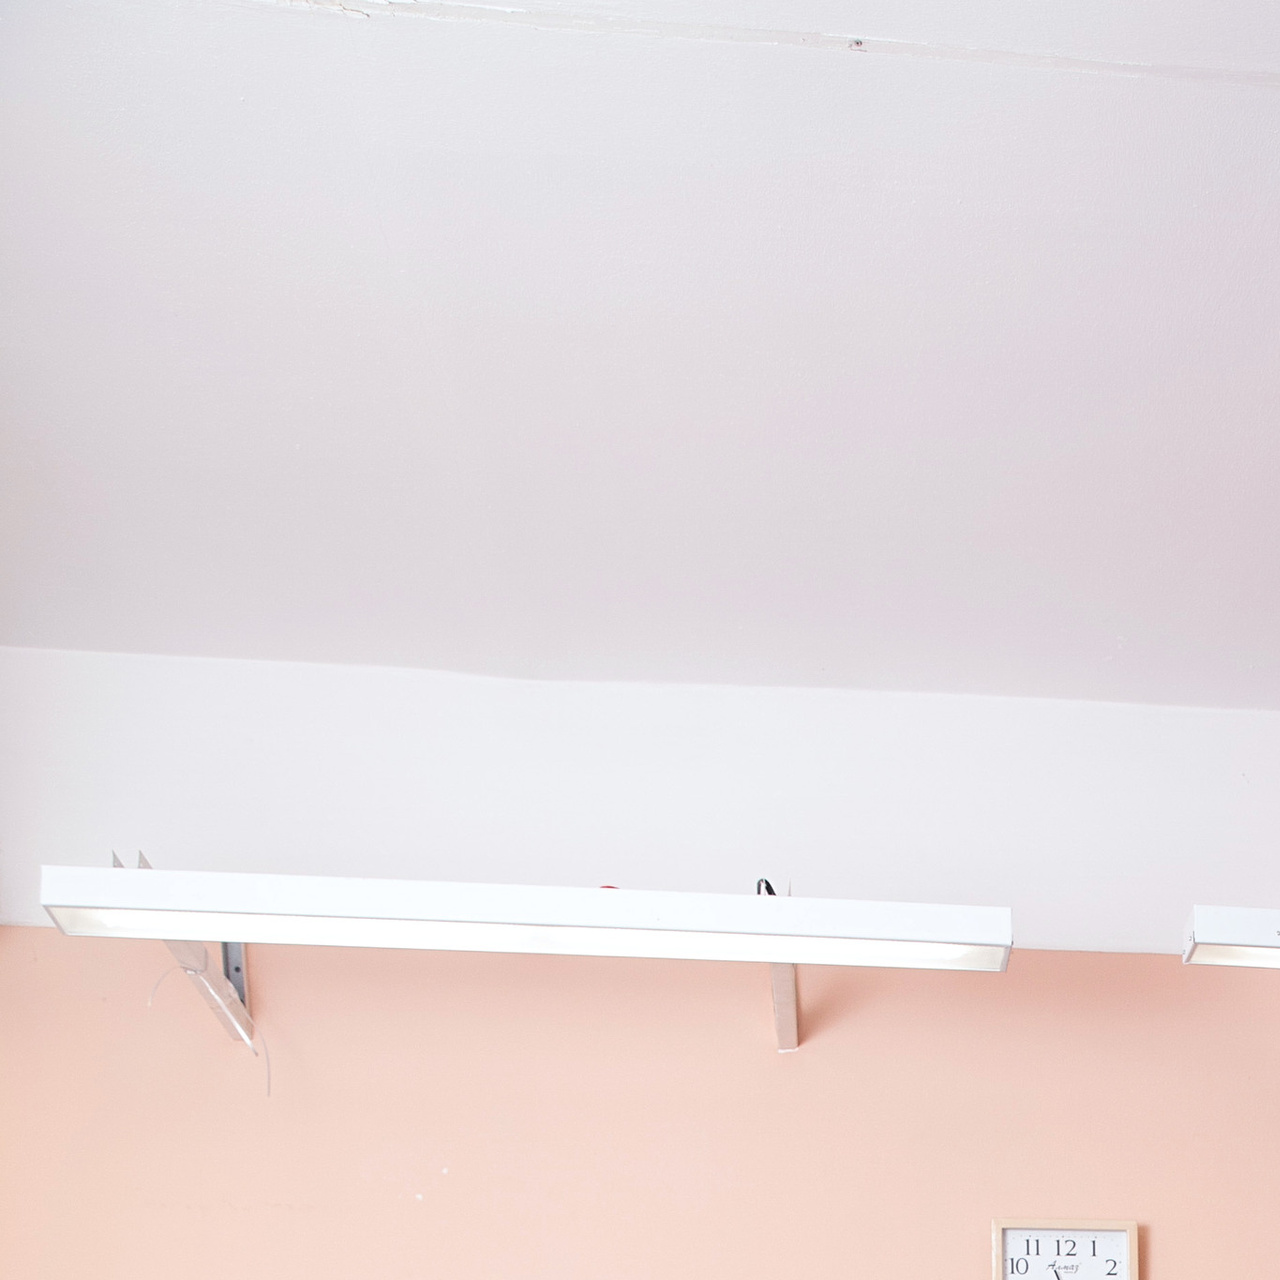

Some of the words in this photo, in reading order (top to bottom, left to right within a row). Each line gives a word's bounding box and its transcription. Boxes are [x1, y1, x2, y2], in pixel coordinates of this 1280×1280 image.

[1025, 1239, 1041, 1256] 11
[1055, 1239, 1077, 1256] 12
[1090, 1240, 1097, 1257] 1
[1009, 1257, 1029, 1275] 10
[1105, 1259, 1118, 1276] 2
